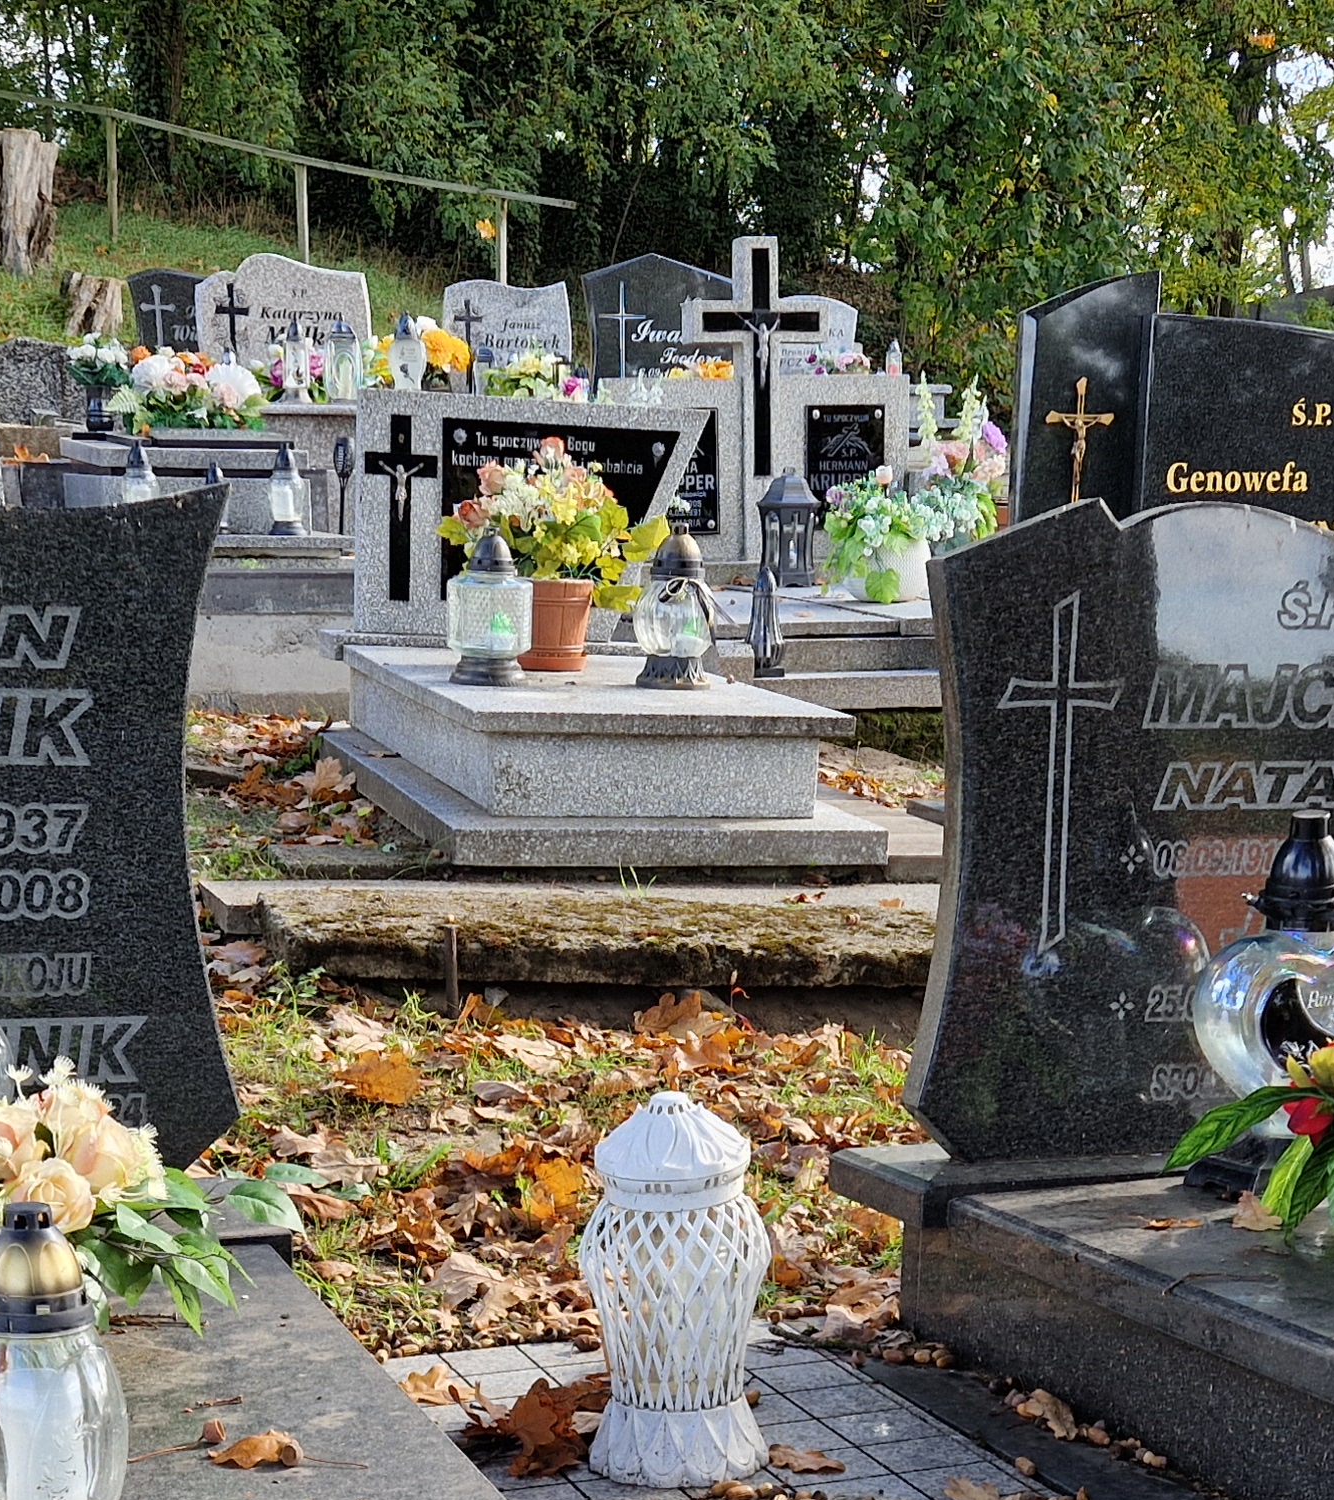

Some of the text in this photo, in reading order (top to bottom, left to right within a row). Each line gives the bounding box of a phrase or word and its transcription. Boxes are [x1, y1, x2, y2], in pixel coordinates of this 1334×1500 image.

[260, 305, 344, 325] Katarzyna
[1291, 397, 1333, 428] Ś.P.
[475, 431, 488, 447] Tu
[567, 437, 596, 456] Bogu
[1166, 461, 1310, 494] Genowefa
